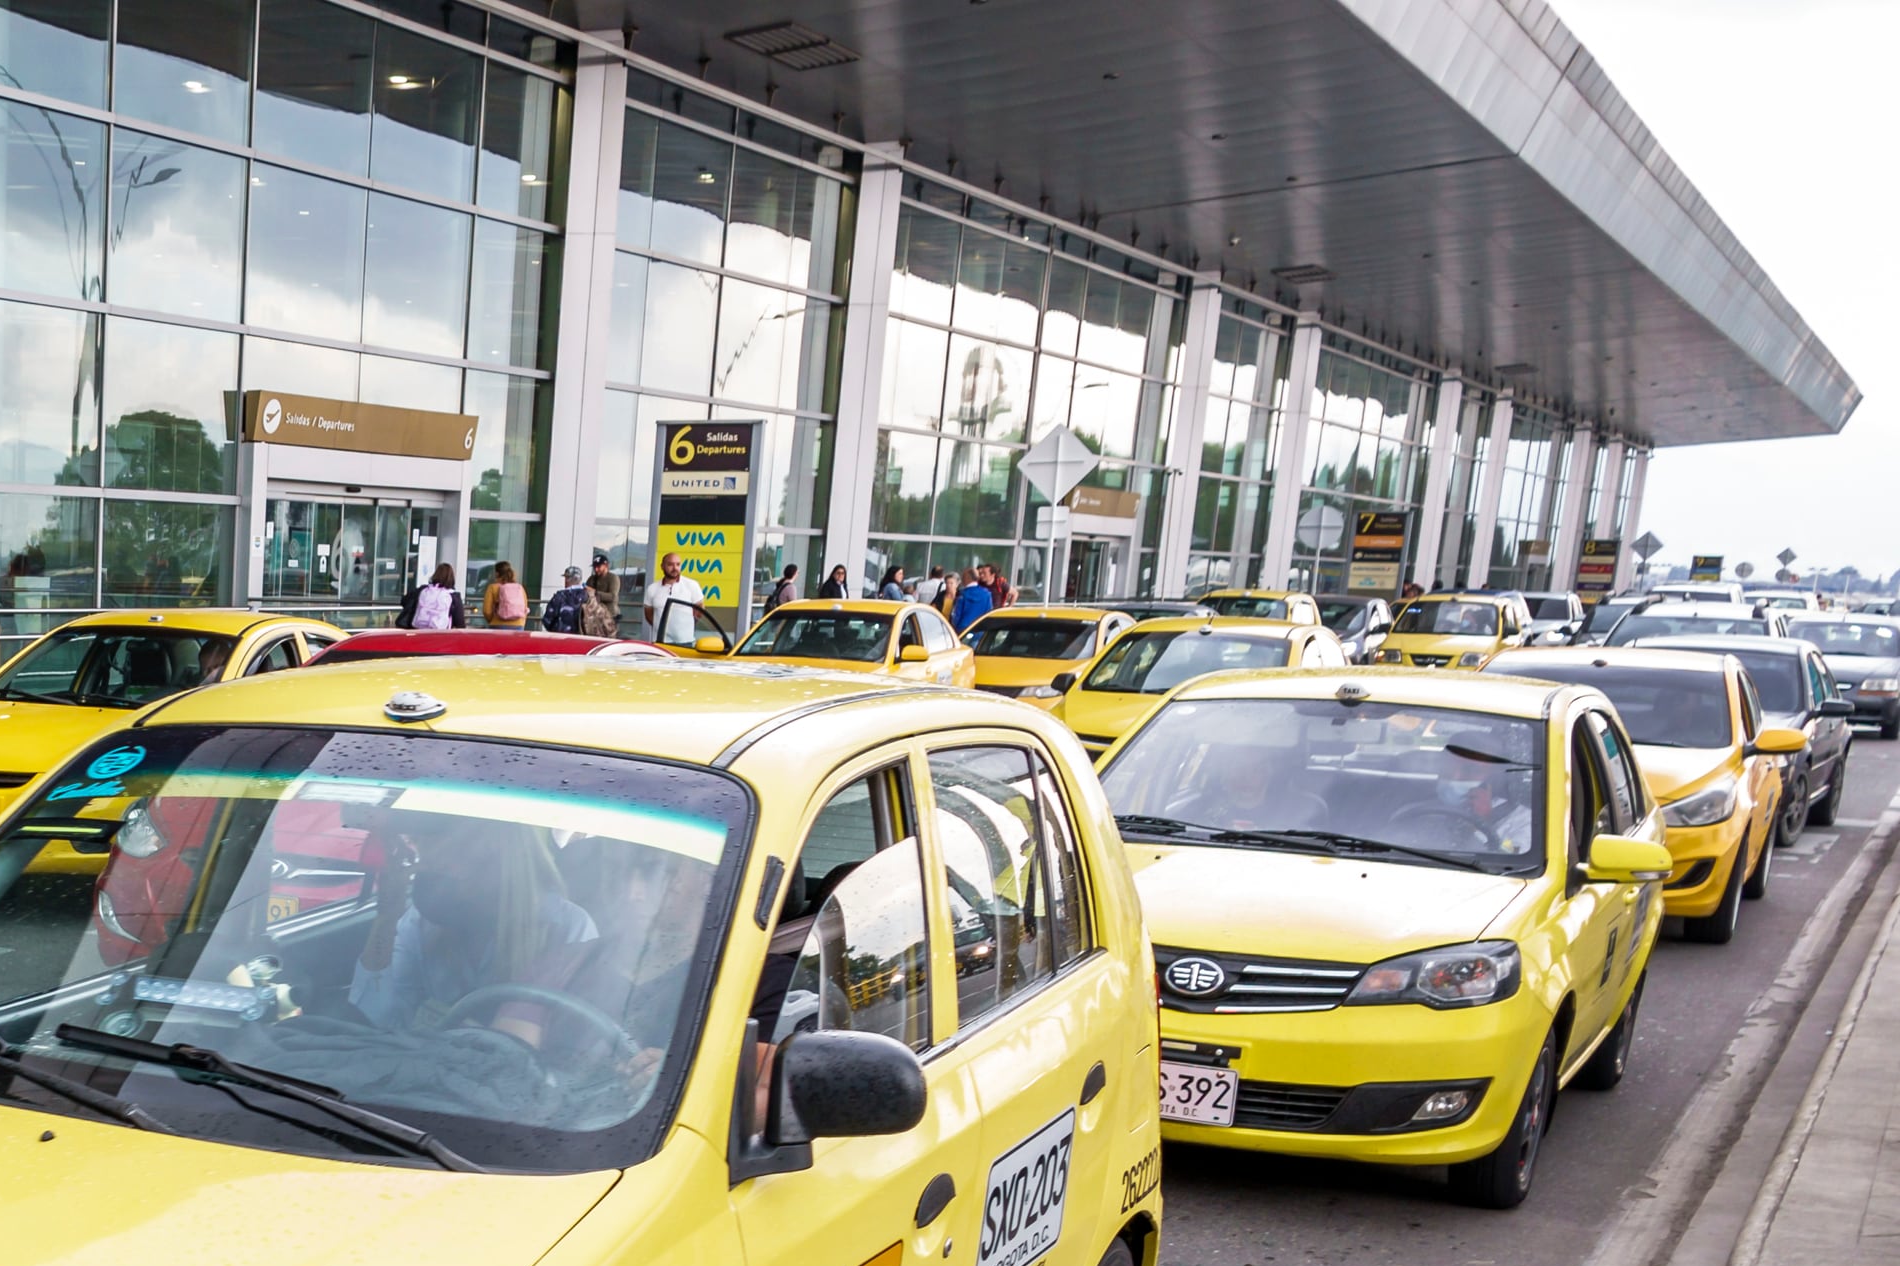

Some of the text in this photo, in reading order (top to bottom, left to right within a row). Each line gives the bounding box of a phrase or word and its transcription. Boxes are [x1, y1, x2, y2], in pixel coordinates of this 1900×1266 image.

[285, 412, 310, 426] Salidas
[318, 416, 355, 432] Departures
[464, 427, 474, 450] 6
[669, 424, 696, 465] 6
[706, 432, 738, 442] Salidas
[696, 444, 747, 456] Departures
[671, 479, 721, 487] UNITED
[1360, 512, 1377, 534] 7
[676, 531, 725, 546] VIVA
